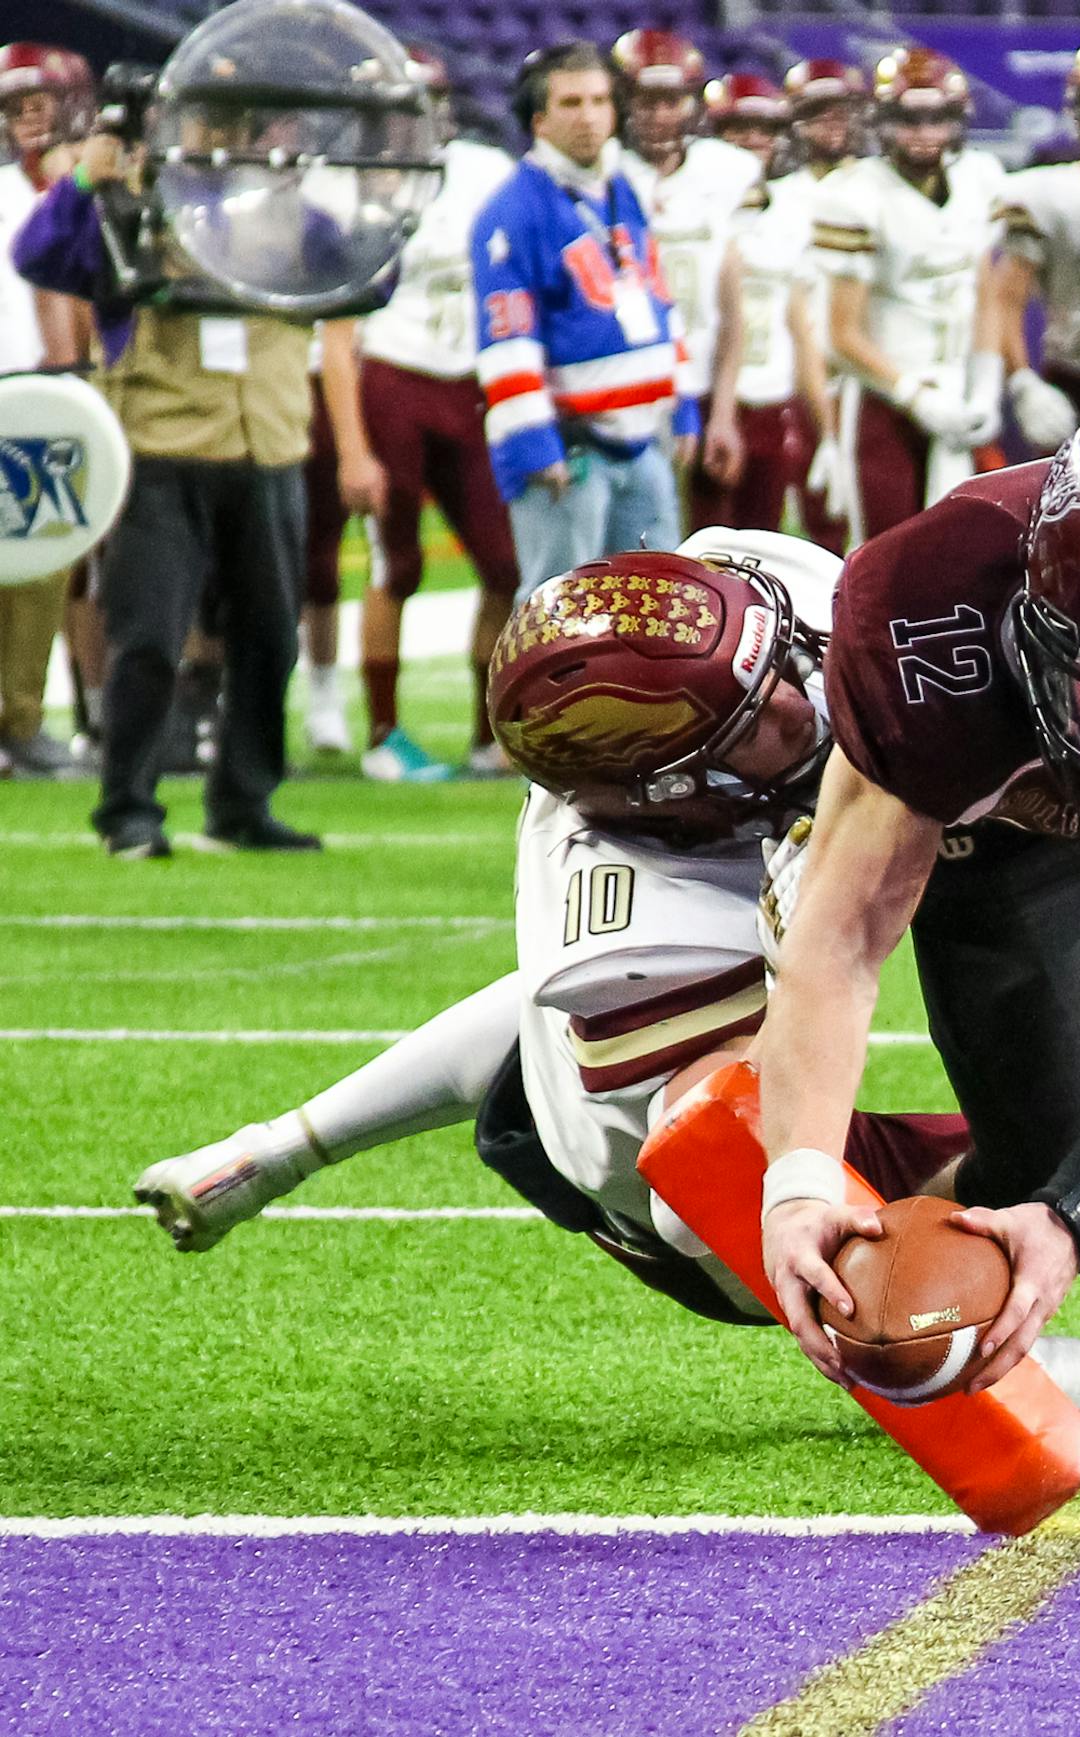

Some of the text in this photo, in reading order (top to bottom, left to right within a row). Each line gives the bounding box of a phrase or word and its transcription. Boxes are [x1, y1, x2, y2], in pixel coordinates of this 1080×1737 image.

[741, 610, 766, 674] Riddell
[889, 604, 992, 704] 12
[563, 863, 636, 947] 10
